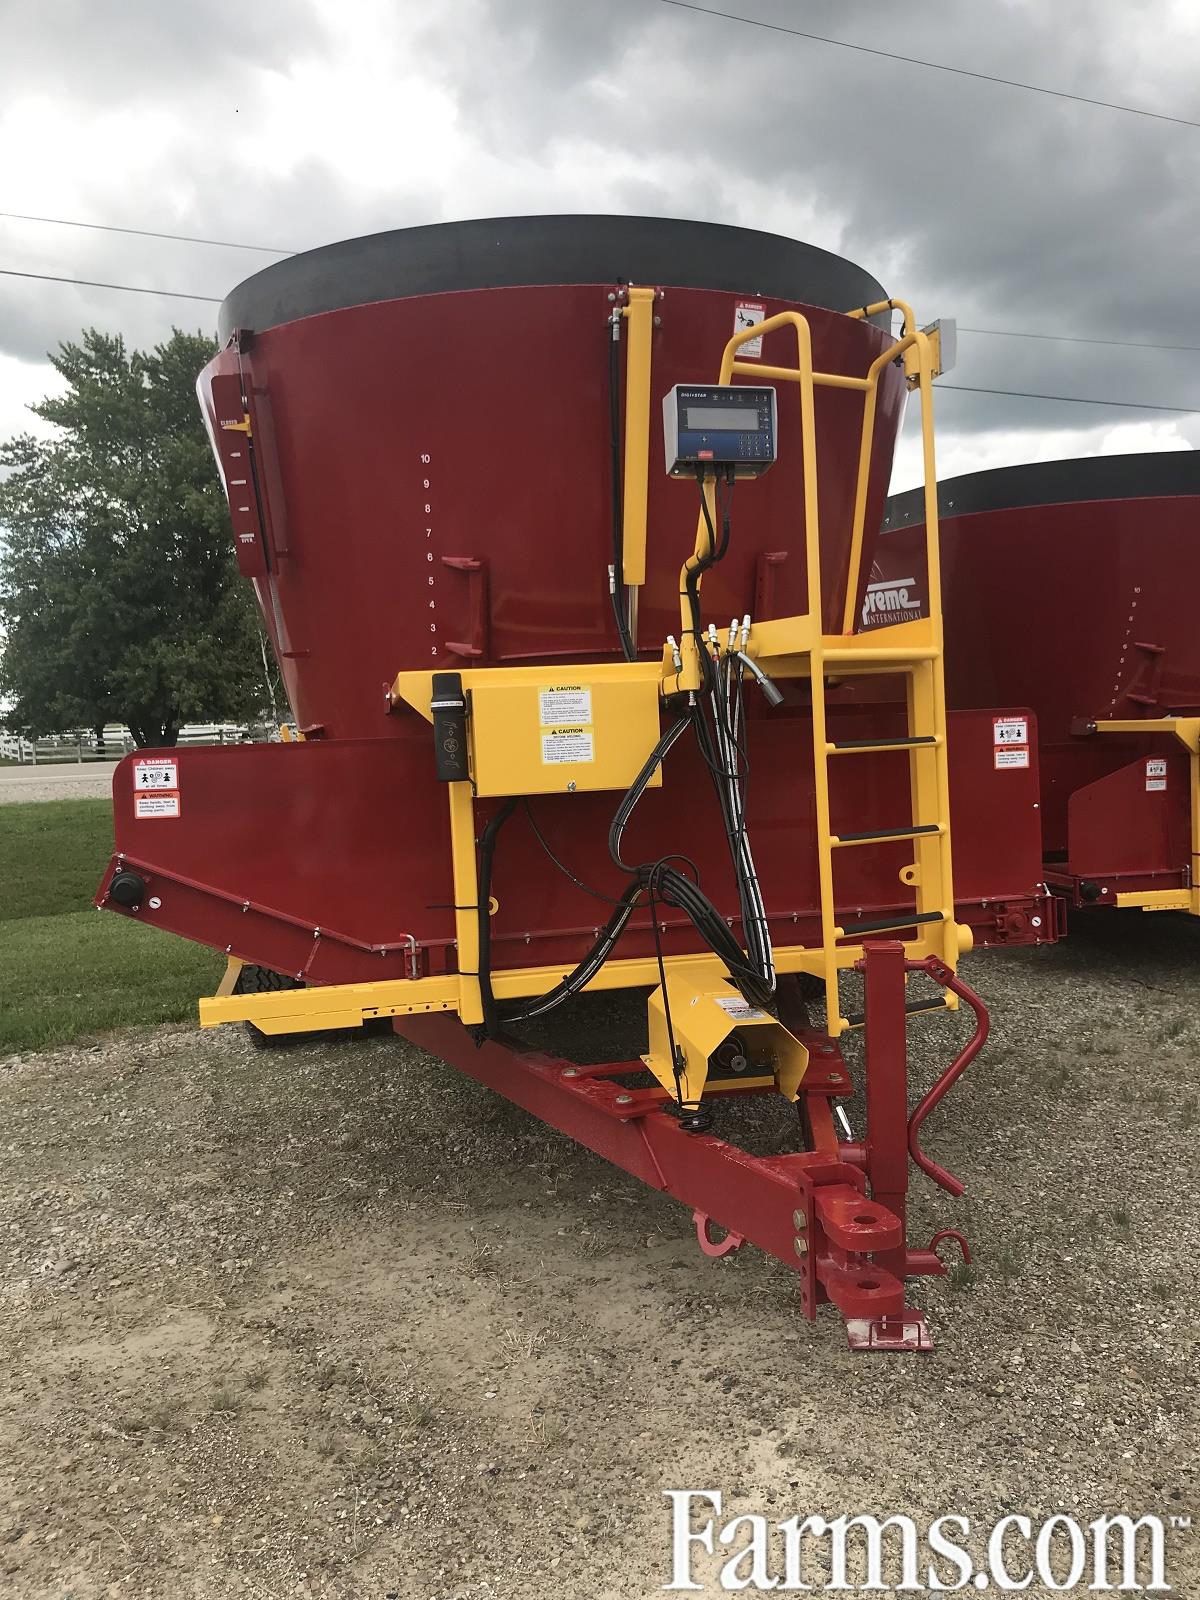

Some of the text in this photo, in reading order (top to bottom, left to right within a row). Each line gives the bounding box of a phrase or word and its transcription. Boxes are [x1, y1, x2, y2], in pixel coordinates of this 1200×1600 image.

[420, 454, 431, 464] 10
[423, 479, 430, 489] 9
[424, 503, 431, 513] 8
[426, 528, 432, 538] 7
[427, 552, 433, 562] 6
[428, 576, 434, 586] 5
[429, 600, 436, 609] 4
[430, 623, 436, 632] 3
[431, 646, 437, 655] 2
